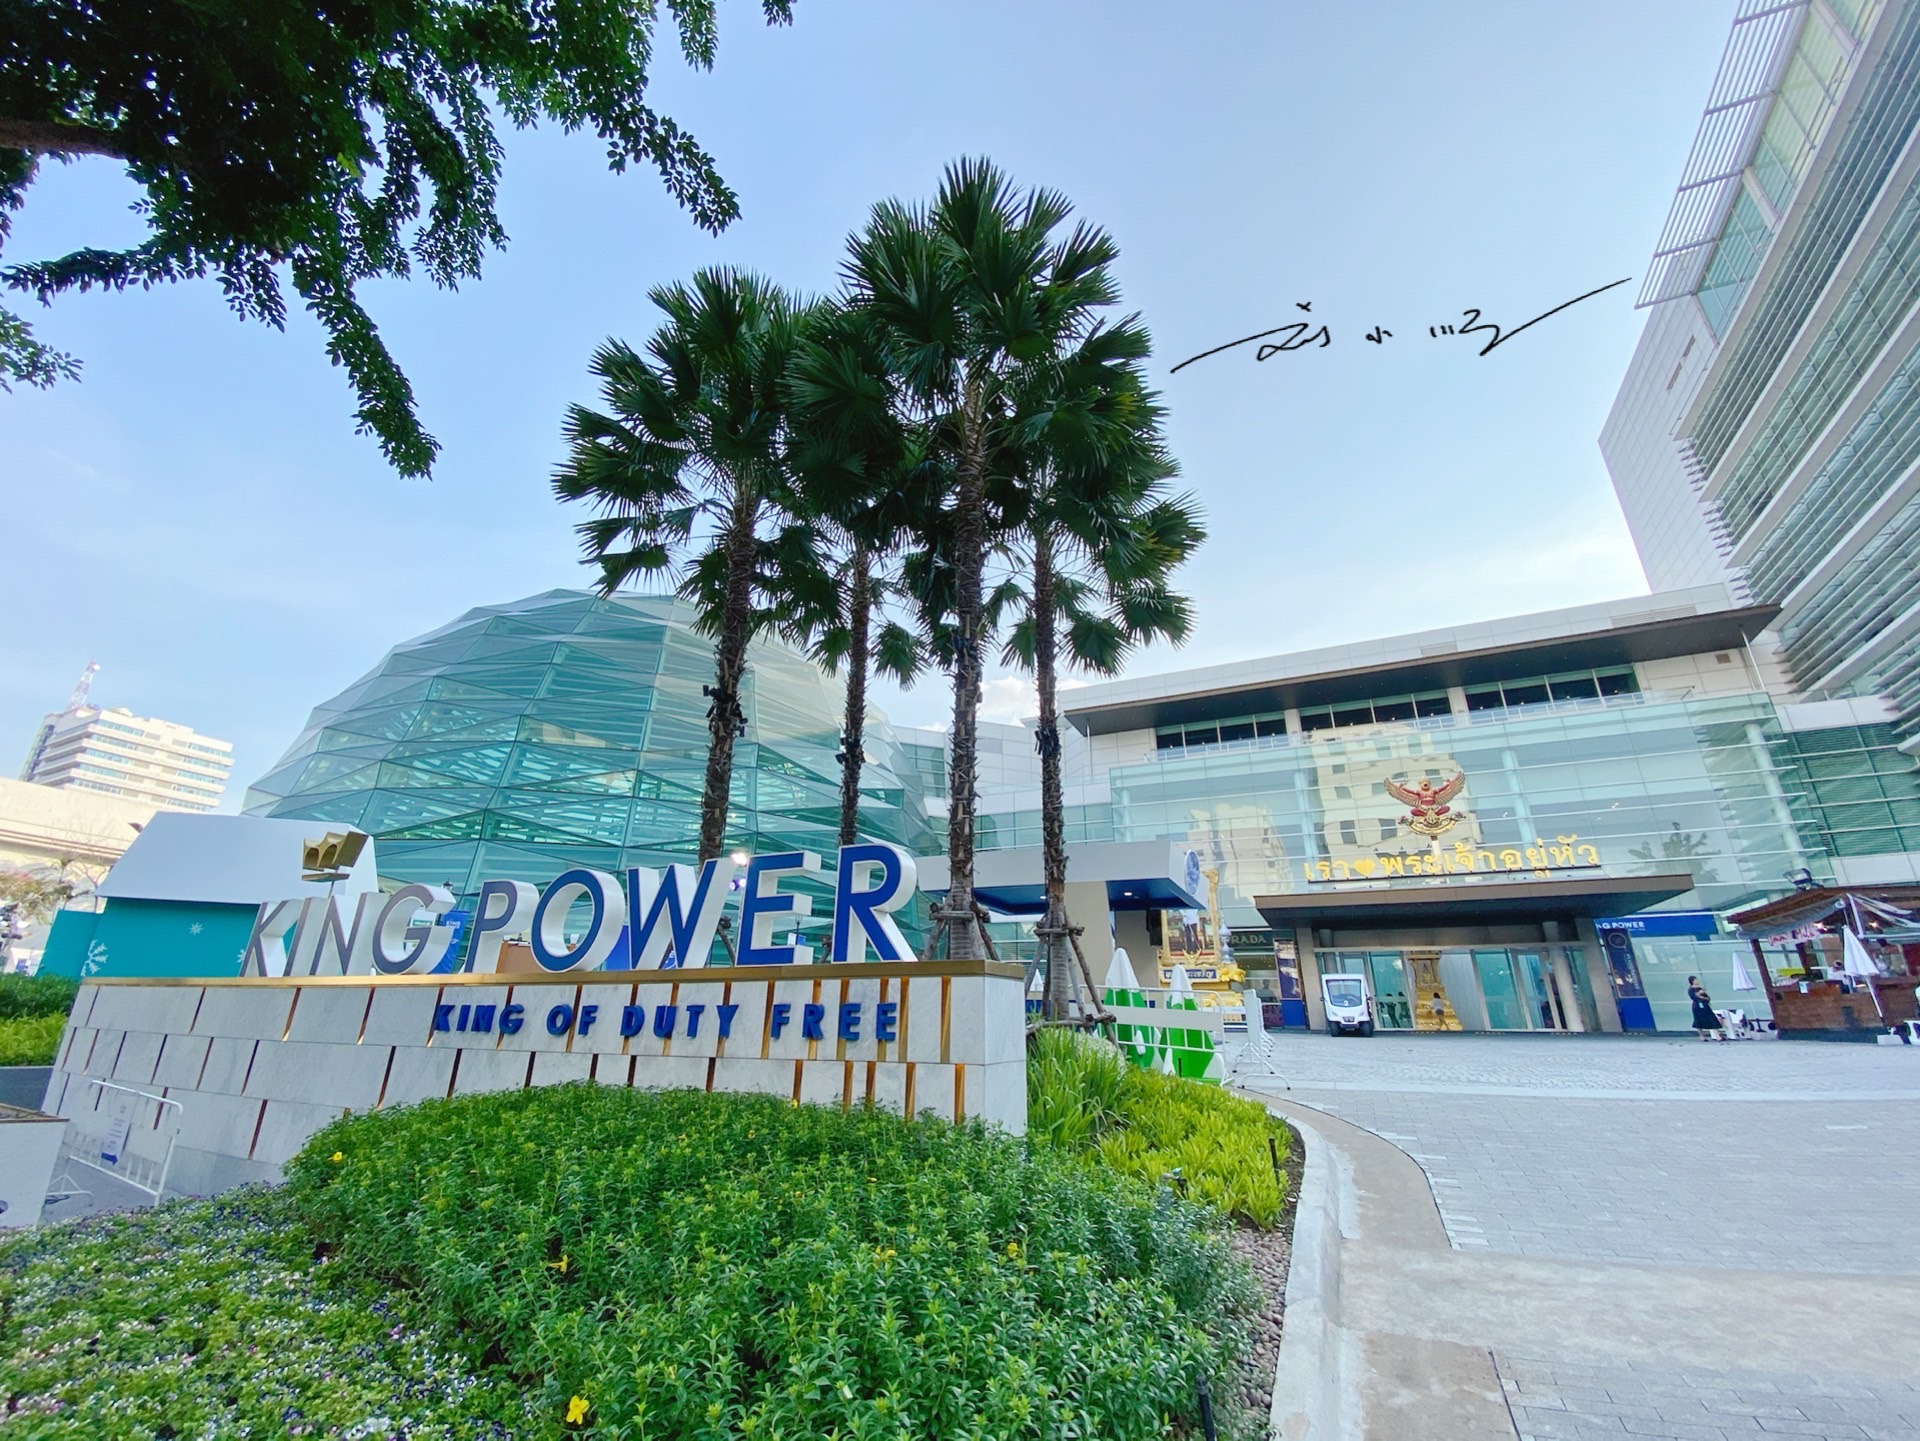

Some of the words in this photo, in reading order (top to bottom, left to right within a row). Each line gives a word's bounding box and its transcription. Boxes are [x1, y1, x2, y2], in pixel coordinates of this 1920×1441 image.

[1304, 856, 1350, 880] เรา
[239, 884, 455, 977] KING
[465, 842, 917, 974] POWER
[1612, 921, 1645, 929] POWER
[1231, 934, 1268, 944] RADA
[433, 1004, 525, 1035] KING
[546, 1003, 599, 1036] OF
[620, 1004, 739, 1039] DUTY
[770, 1003, 898, 1041] FREE
